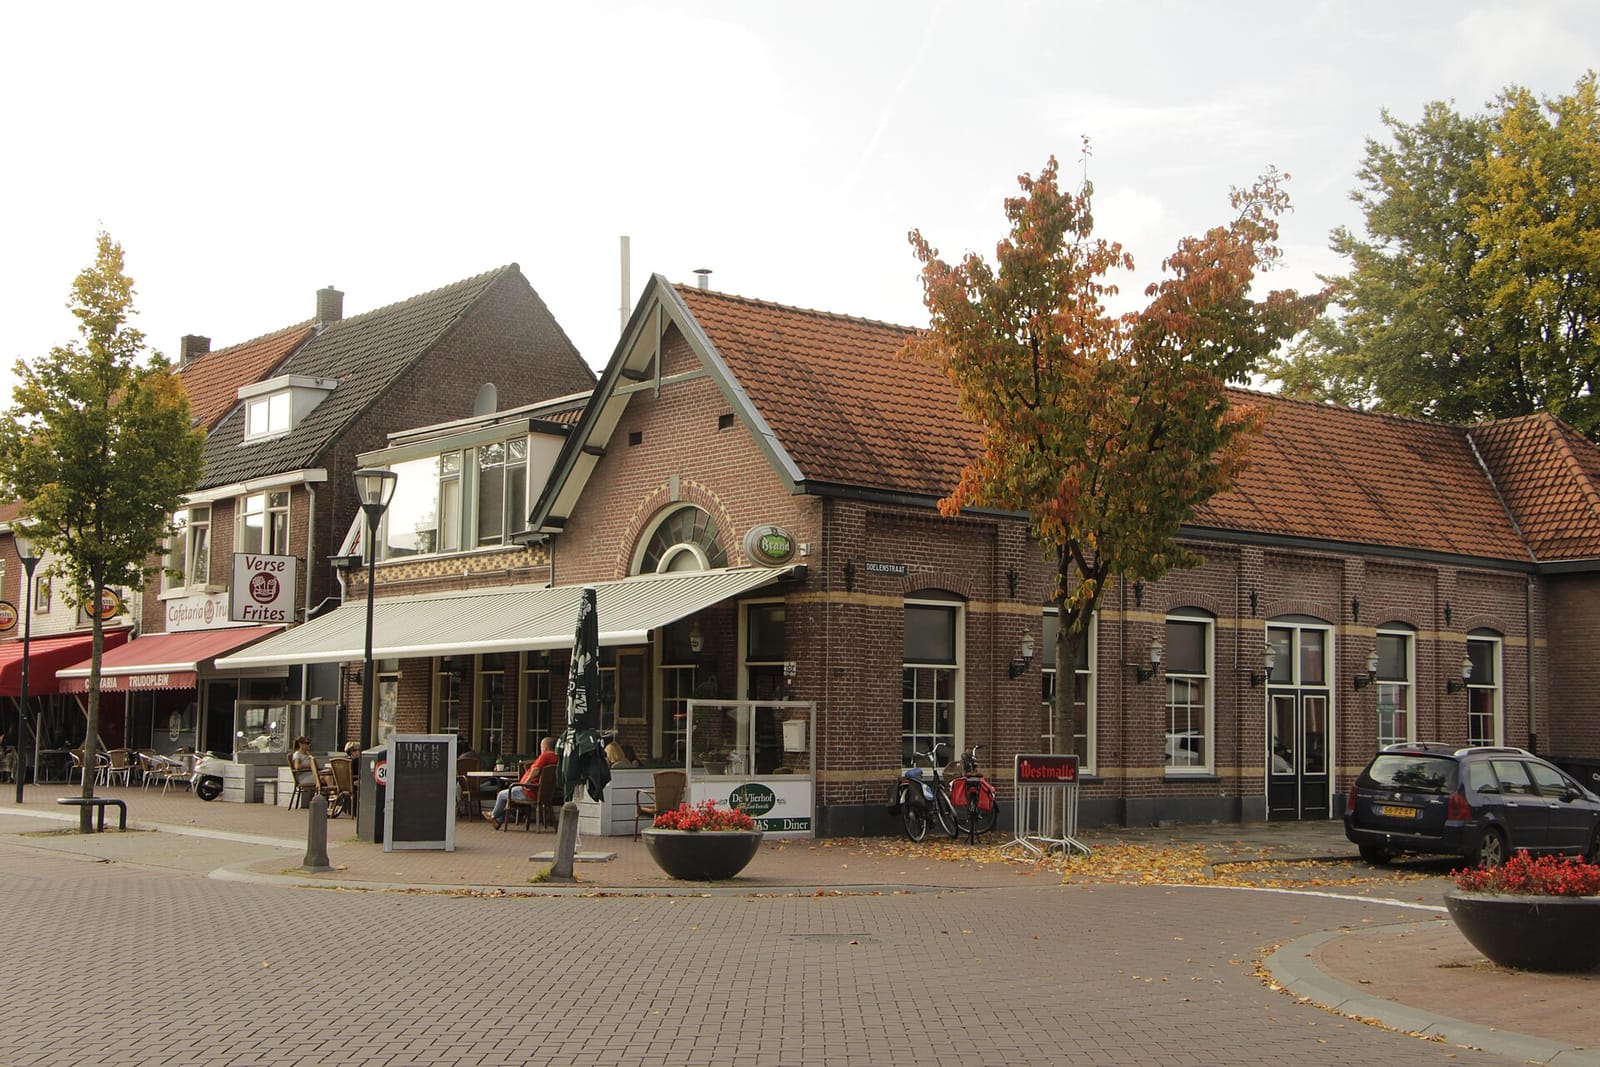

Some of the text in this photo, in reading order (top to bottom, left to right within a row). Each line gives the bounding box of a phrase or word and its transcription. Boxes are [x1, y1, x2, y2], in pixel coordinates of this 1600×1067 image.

[761, 537, 790, 552] Brand
[245, 555, 286, 572] Verse
[866, 562, 905, 573] DOELENSTRAAT
[168, 601, 204, 626] Cafetaria
[242, 605, 286, 621] Frites
[84, 673, 170, 689] CTARIA TRUDOPLEIN
[1020, 762, 1075, 778] Westmalle
[732, 793, 742, 803] De
[783, 818, 808, 830] Diner
